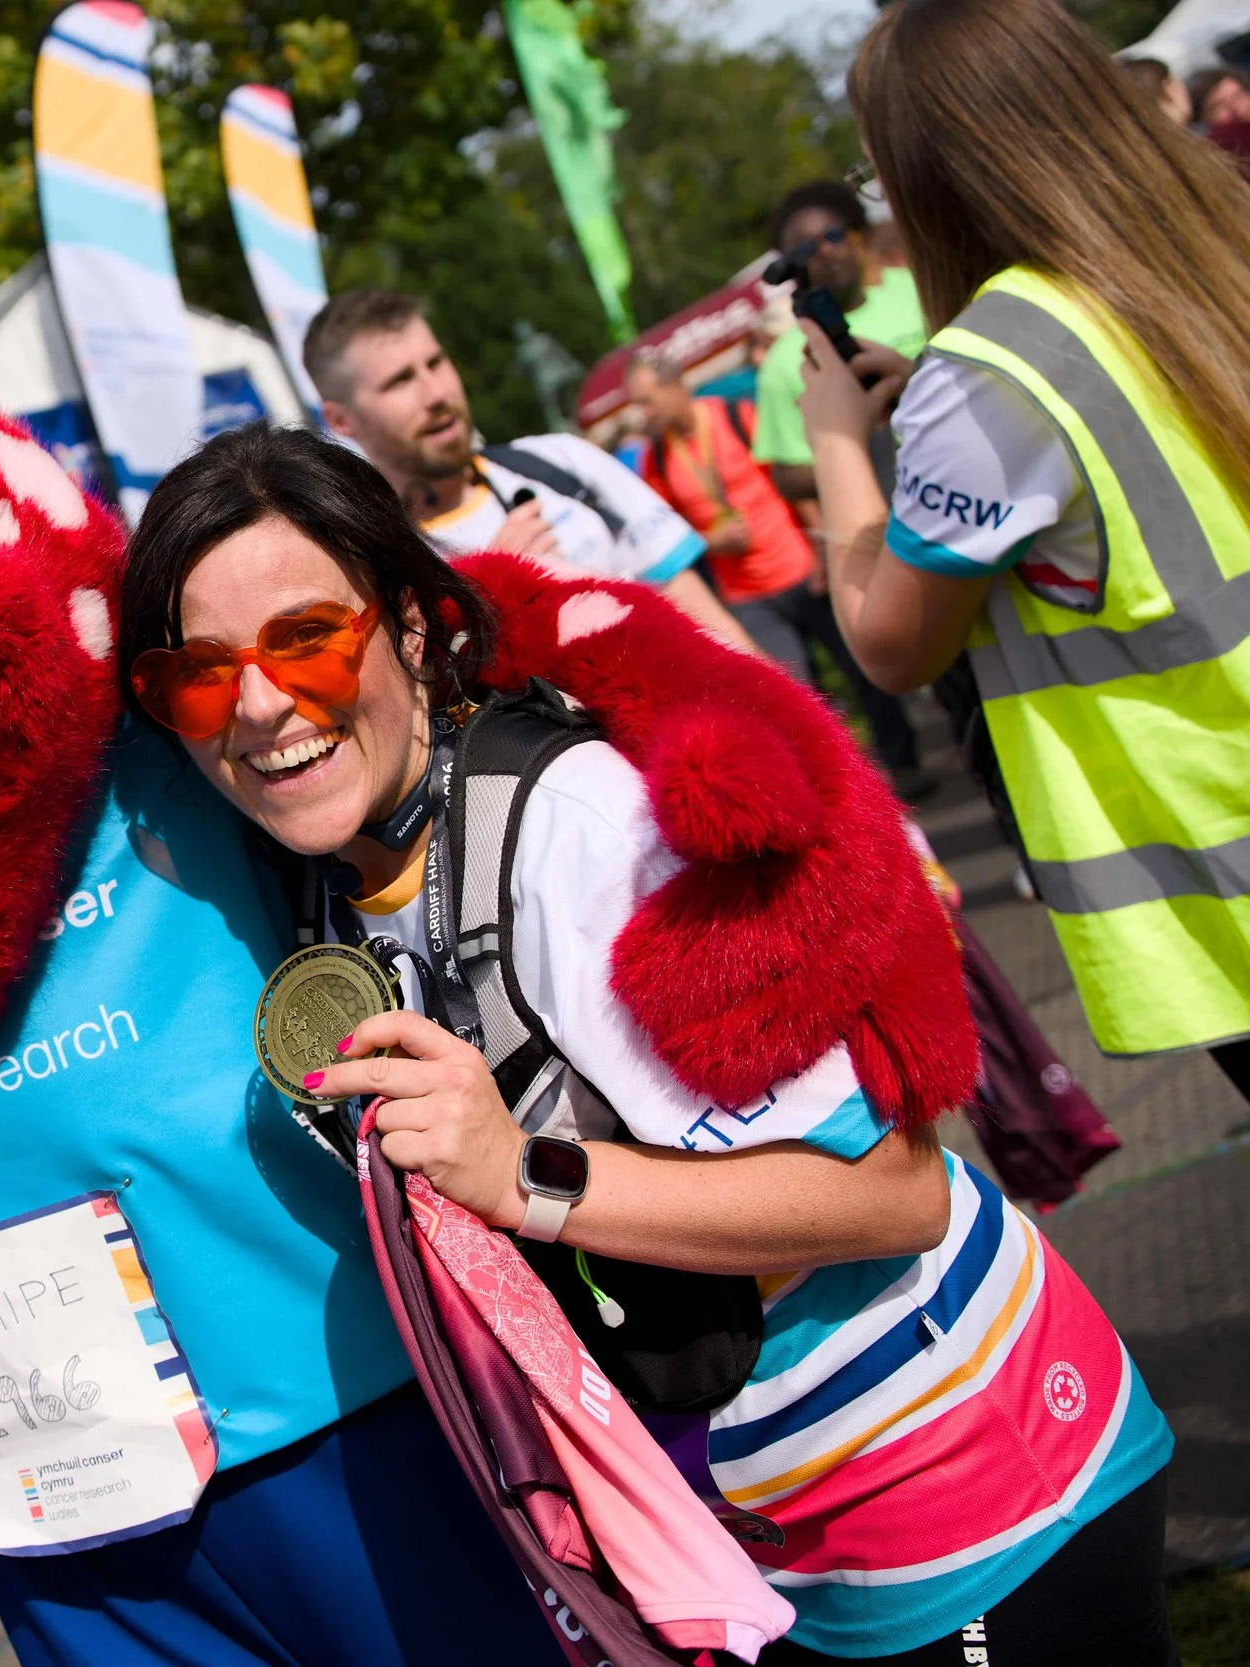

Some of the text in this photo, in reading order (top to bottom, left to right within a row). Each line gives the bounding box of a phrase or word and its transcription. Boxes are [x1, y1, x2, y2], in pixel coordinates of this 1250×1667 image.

[427, 839, 444, 953] CARDIFF HALF
[305, 986, 339, 1019] CARDIFF
[40, 1476, 75, 1492] cymru
[48, 1507, 80, 1522] wales
